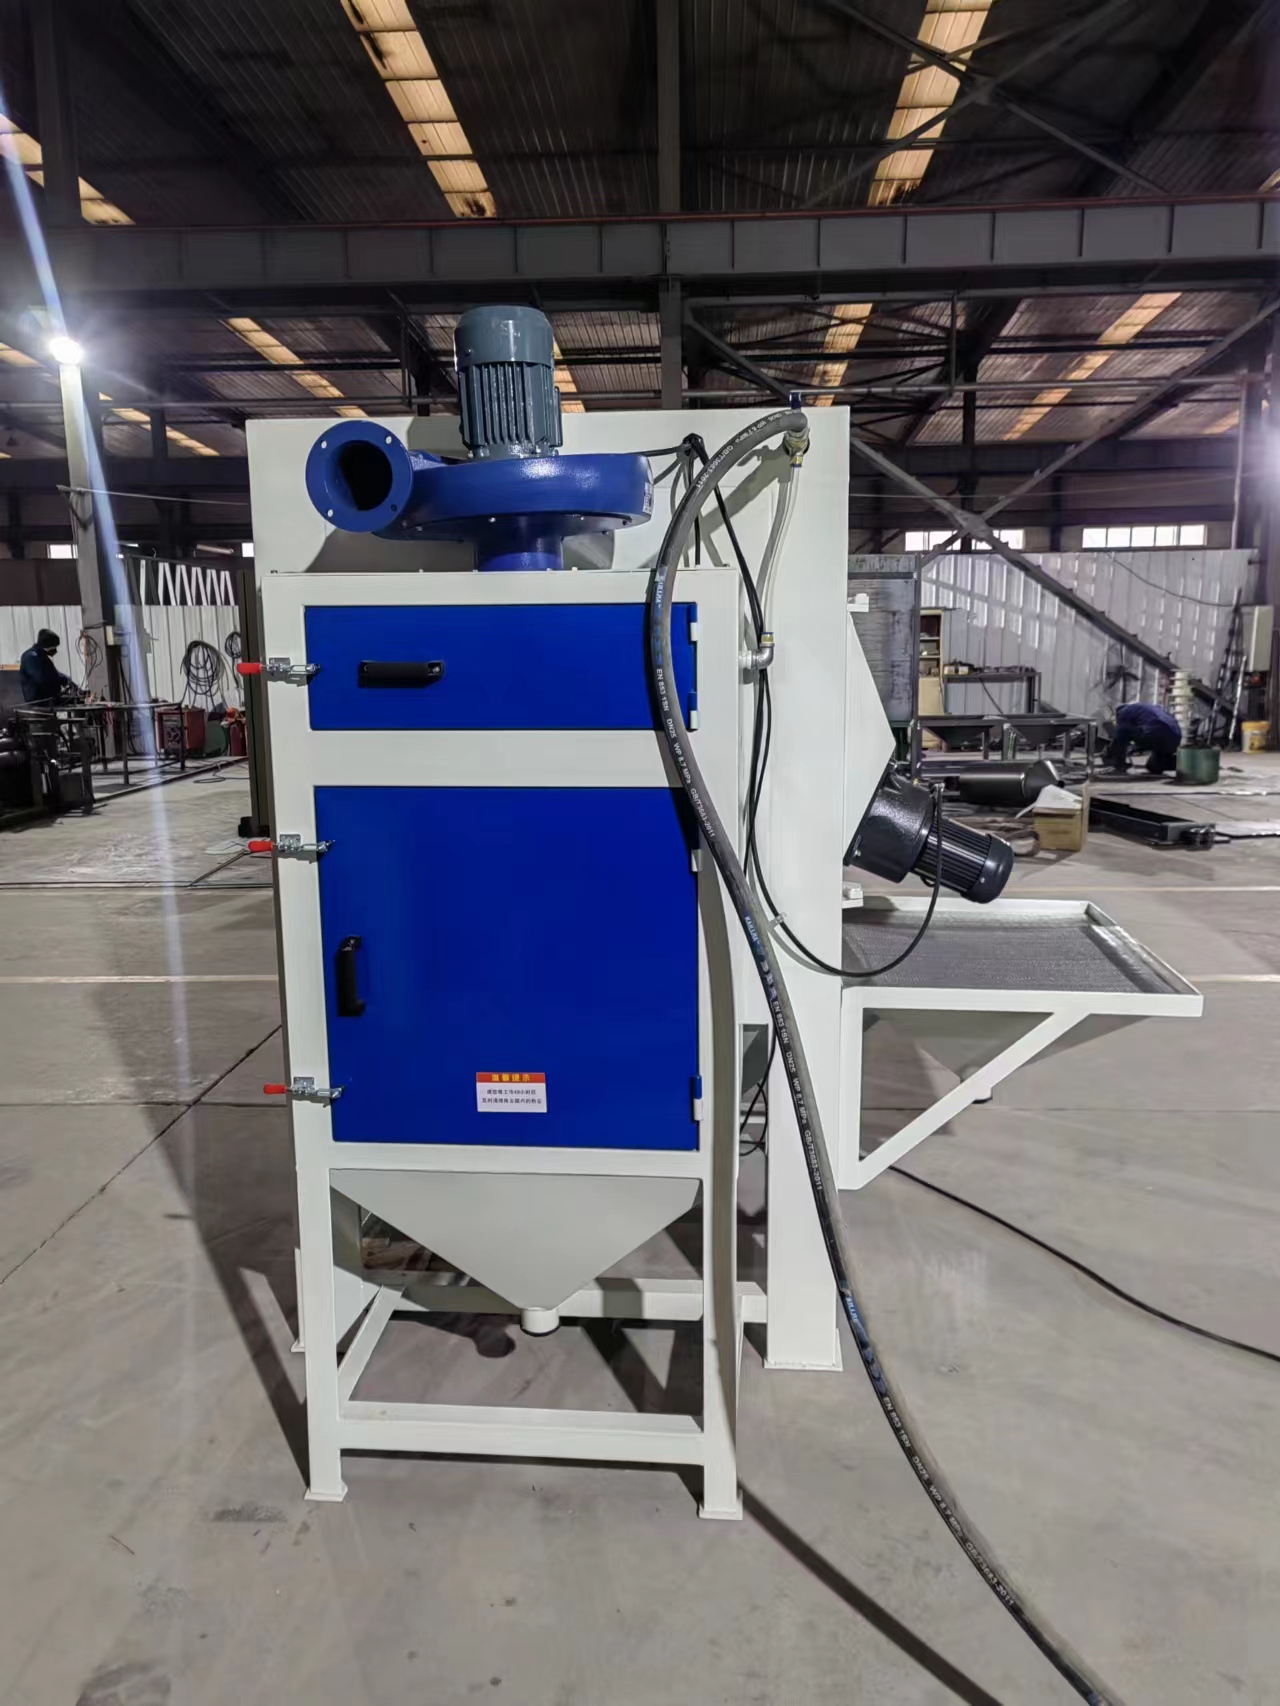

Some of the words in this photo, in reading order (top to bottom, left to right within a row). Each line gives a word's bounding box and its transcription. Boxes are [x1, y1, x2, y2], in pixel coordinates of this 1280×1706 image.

[656, 668, 664, 680] EN
[658, 681, 667, 696] 853
[661, 697, 670, 711] 1SN
[666, 718, 677, 739] DN25
[673, 742, 682, 755] WP
[678, 757, 687, 768] 8.7
[682, 768, 692, 784] MPa
[690, 788, 716, 838] GB/T3683-2011
[772, 1001, 780, 1013] EN
[776, 1014, 785, 1028] 853
[780, 1029, 790, 1044] 1SN
[786, 1051, 796, 1073] DN25
[491, 1074, 530, 1082] 温馨提示
[792, 1078, 801, 1092] WP
[799, 1106, 809, 1125] MPa
[804, 1130, 823, 1191] GB/T3683-2011
[882, 1396, 894, 1411] EN
[890, 1412, 902, 1428] 853
[899, 1430, 912, 1448] 1SN
[912, 1456, 929, 1480] DN25
[930, 1485, 942, 1501] WP
